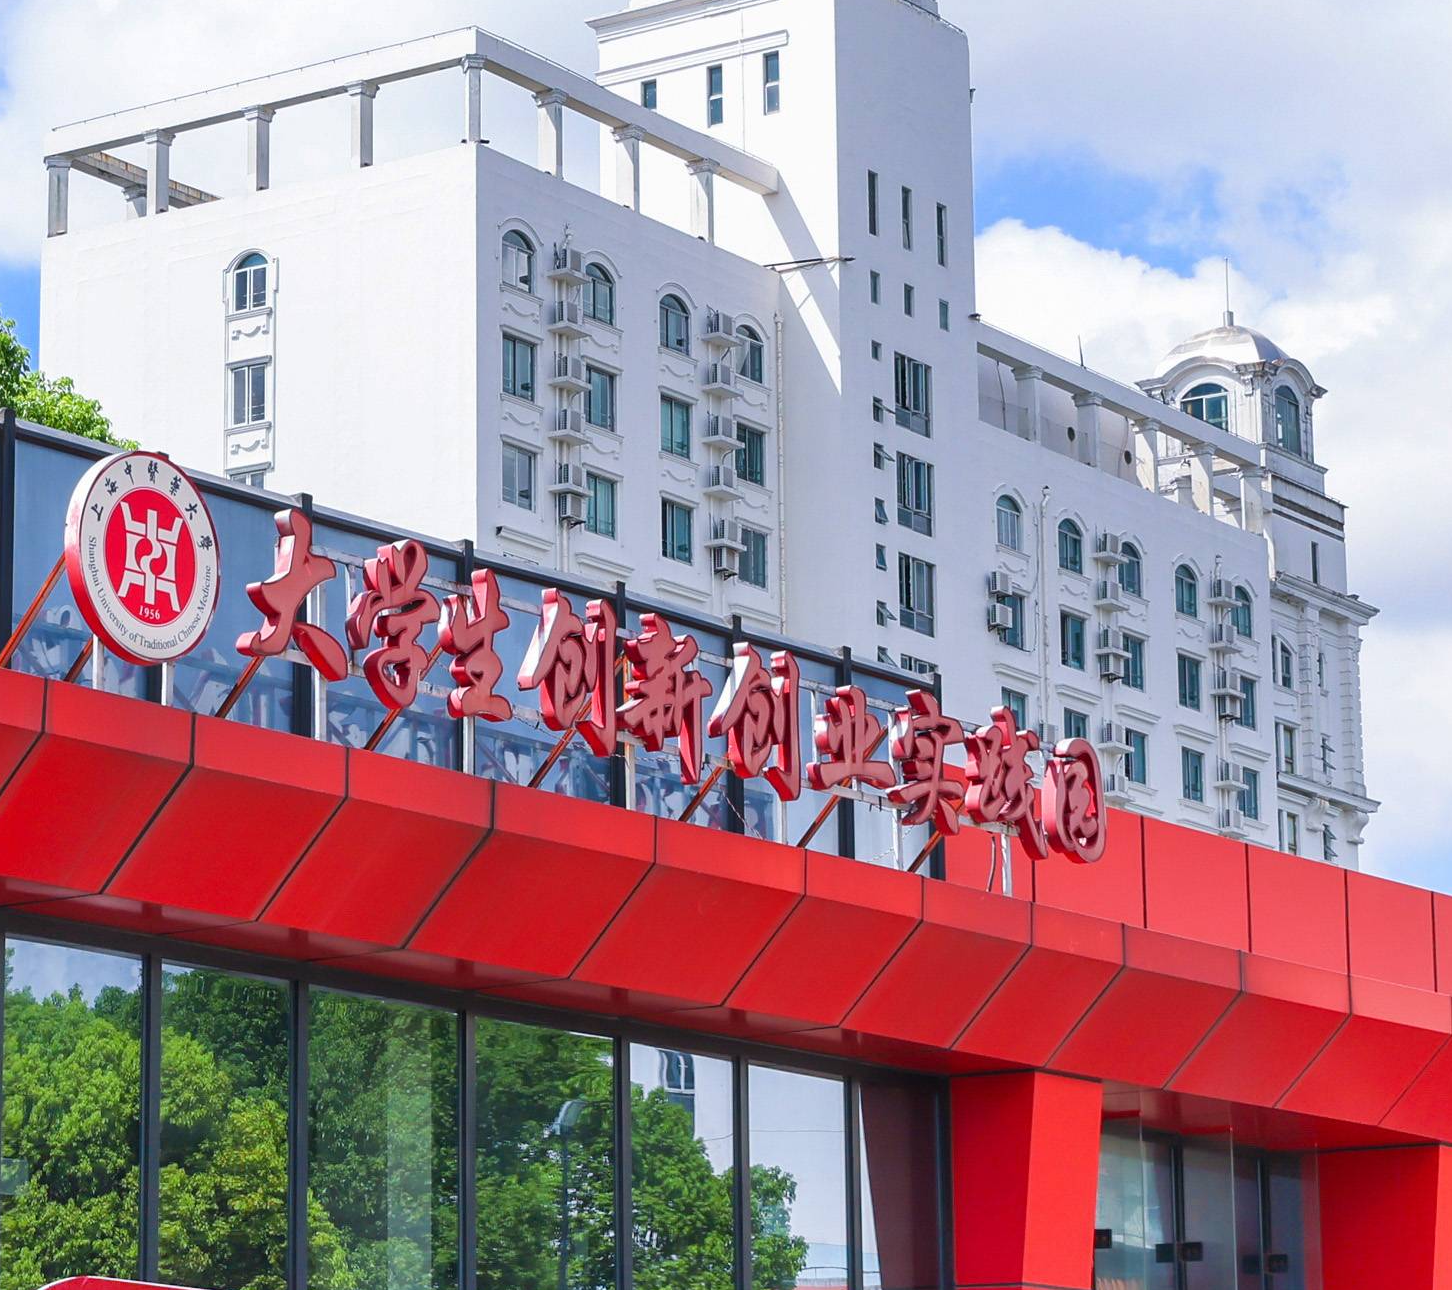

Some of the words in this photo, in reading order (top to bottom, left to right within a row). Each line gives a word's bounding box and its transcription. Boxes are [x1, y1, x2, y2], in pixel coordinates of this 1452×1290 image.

[88, 535, 100, 588] Shanghai
[97, 587, 127, 637] University
[129, 630, 138, 643] of
[139, 634, 178, 650] Traditional
[178, 613, 201, 638] Chinese
[197, 565, 212, 612] Medicine
[138, 605, 161, 620] 1956
[236, 508, 1107, 865] 大学生创新创业实践园
